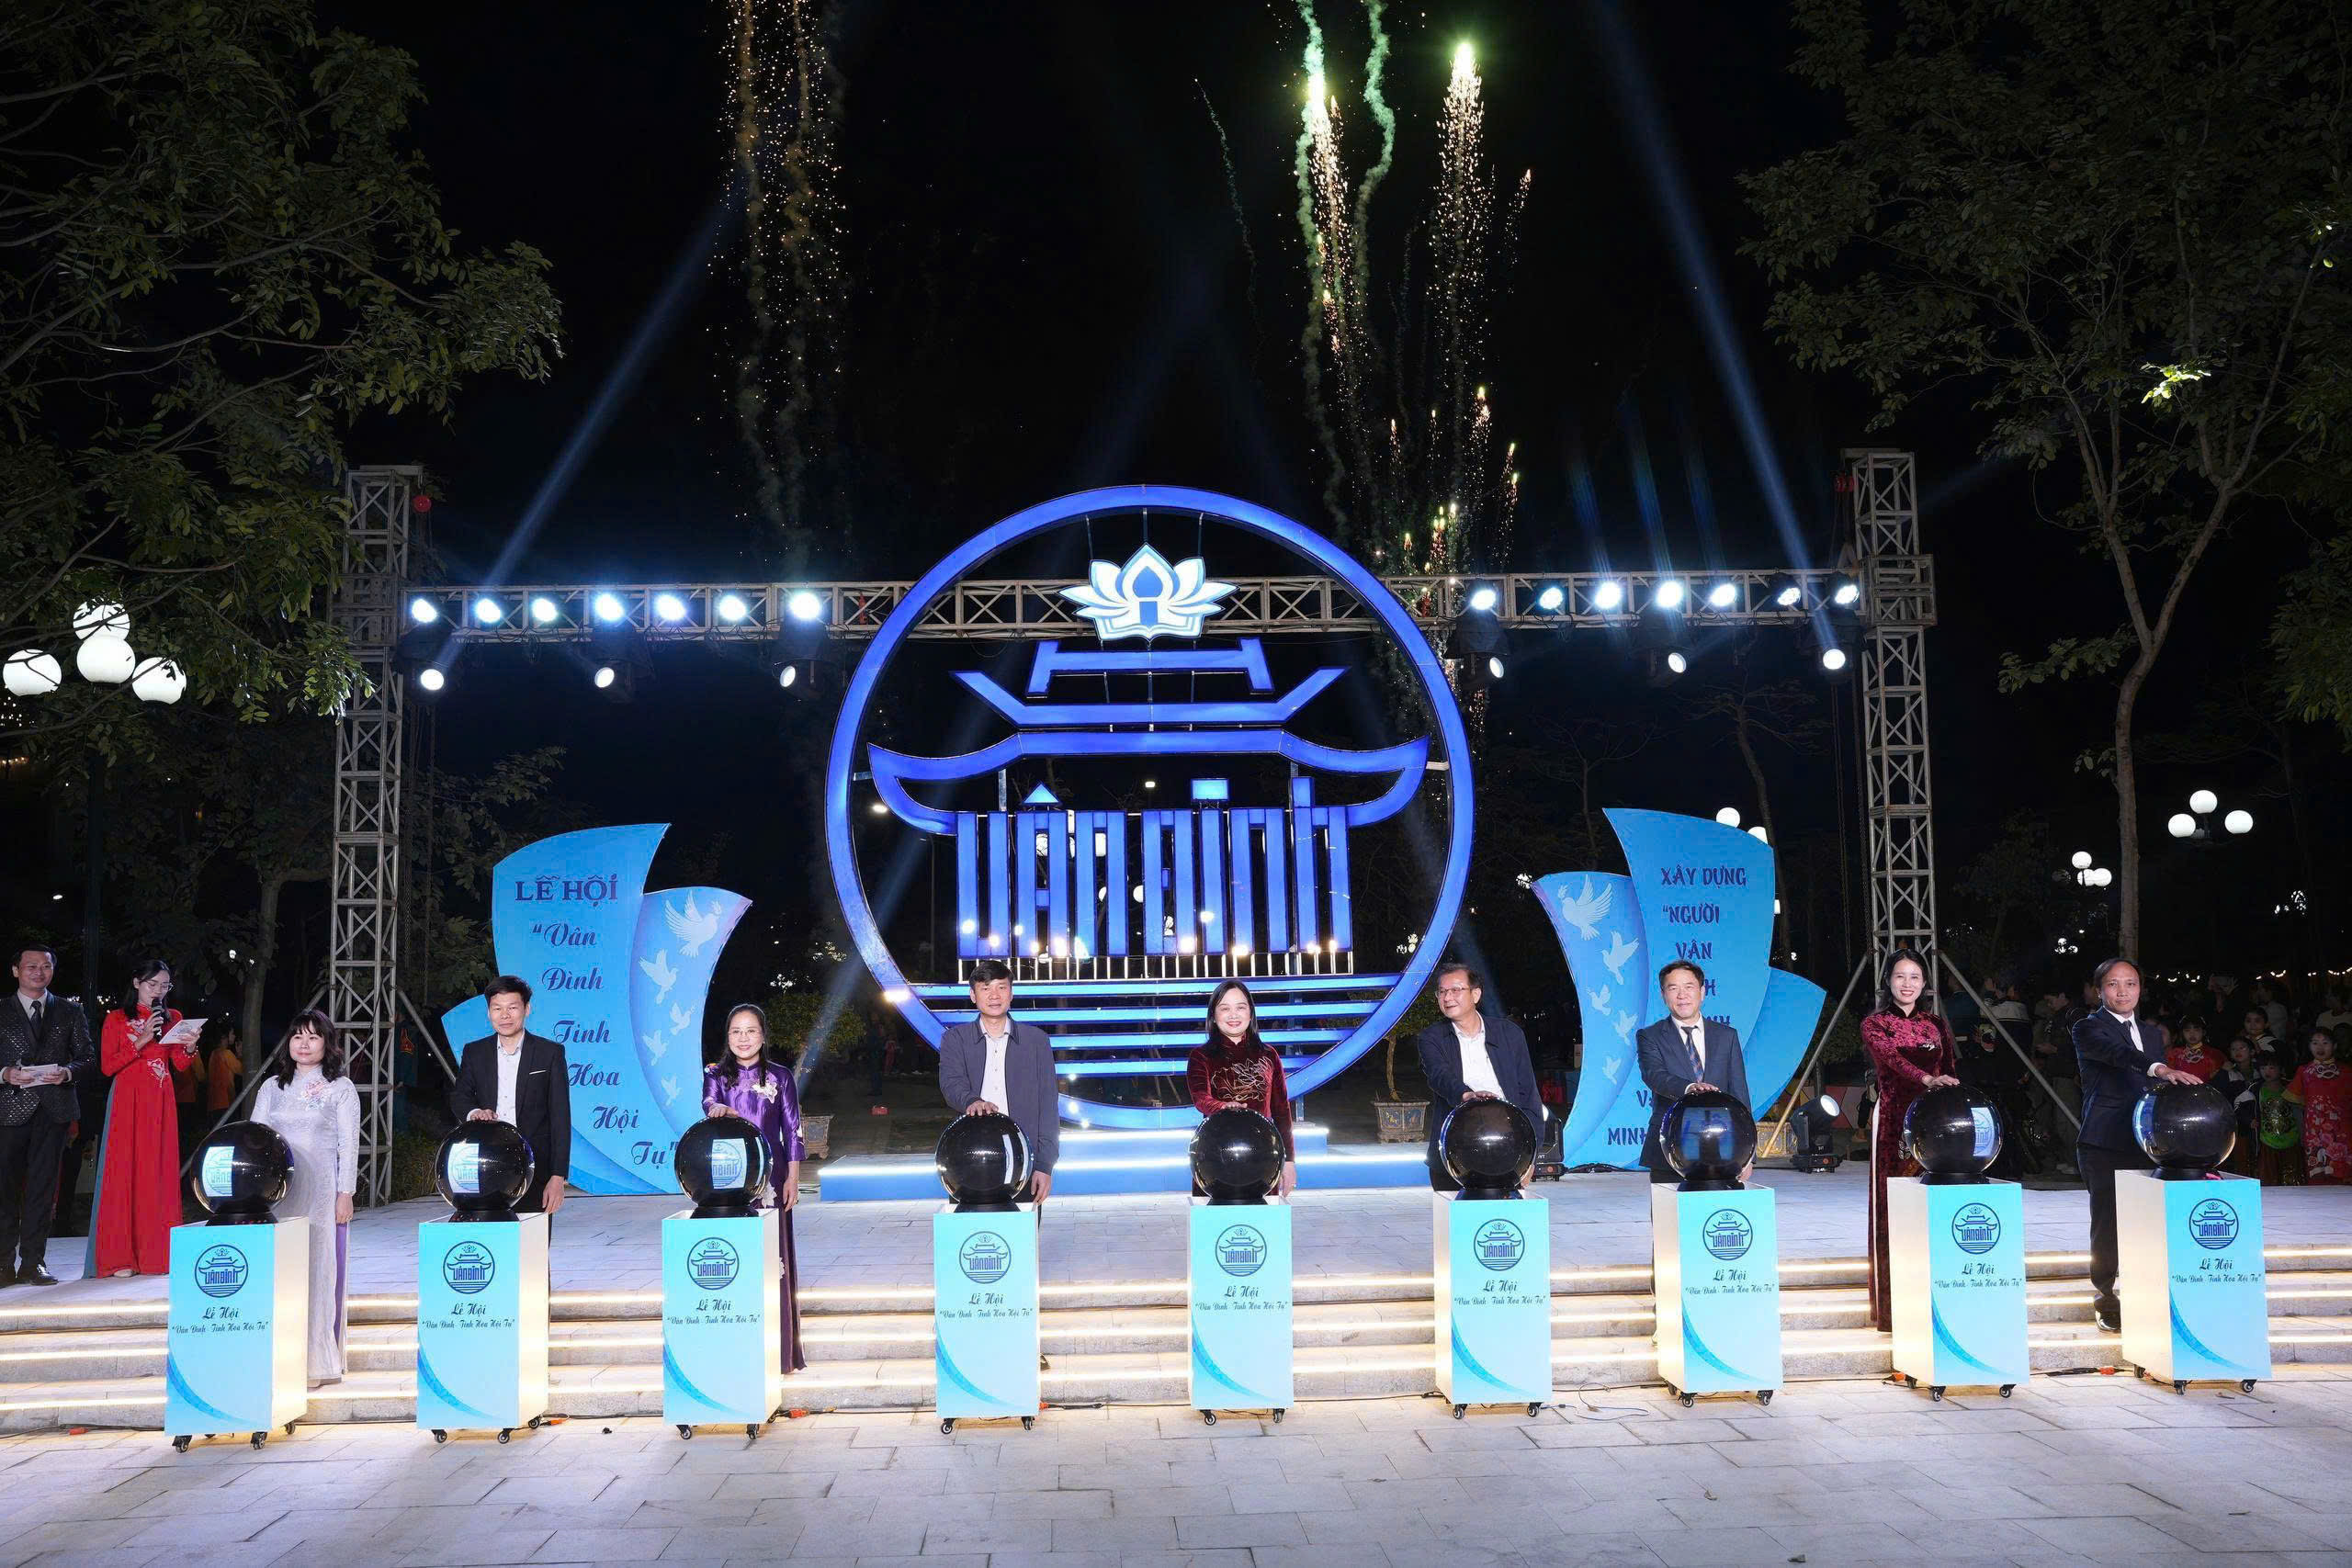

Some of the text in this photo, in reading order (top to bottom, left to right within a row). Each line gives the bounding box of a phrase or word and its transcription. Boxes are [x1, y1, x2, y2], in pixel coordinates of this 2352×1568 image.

[1661, 864, 1747, 889] XÂY DỰNG
[514, 874, 618, 908] LỄ HỘI
[1675, 939, 1713, 960] VÂN
[541, 967, 605, 991] Đình
[553, 1020, 612, 1043] Tinh
[568, 1063, 621, 1087] Hoa
[593, 1106, 640, 1134] Hội
